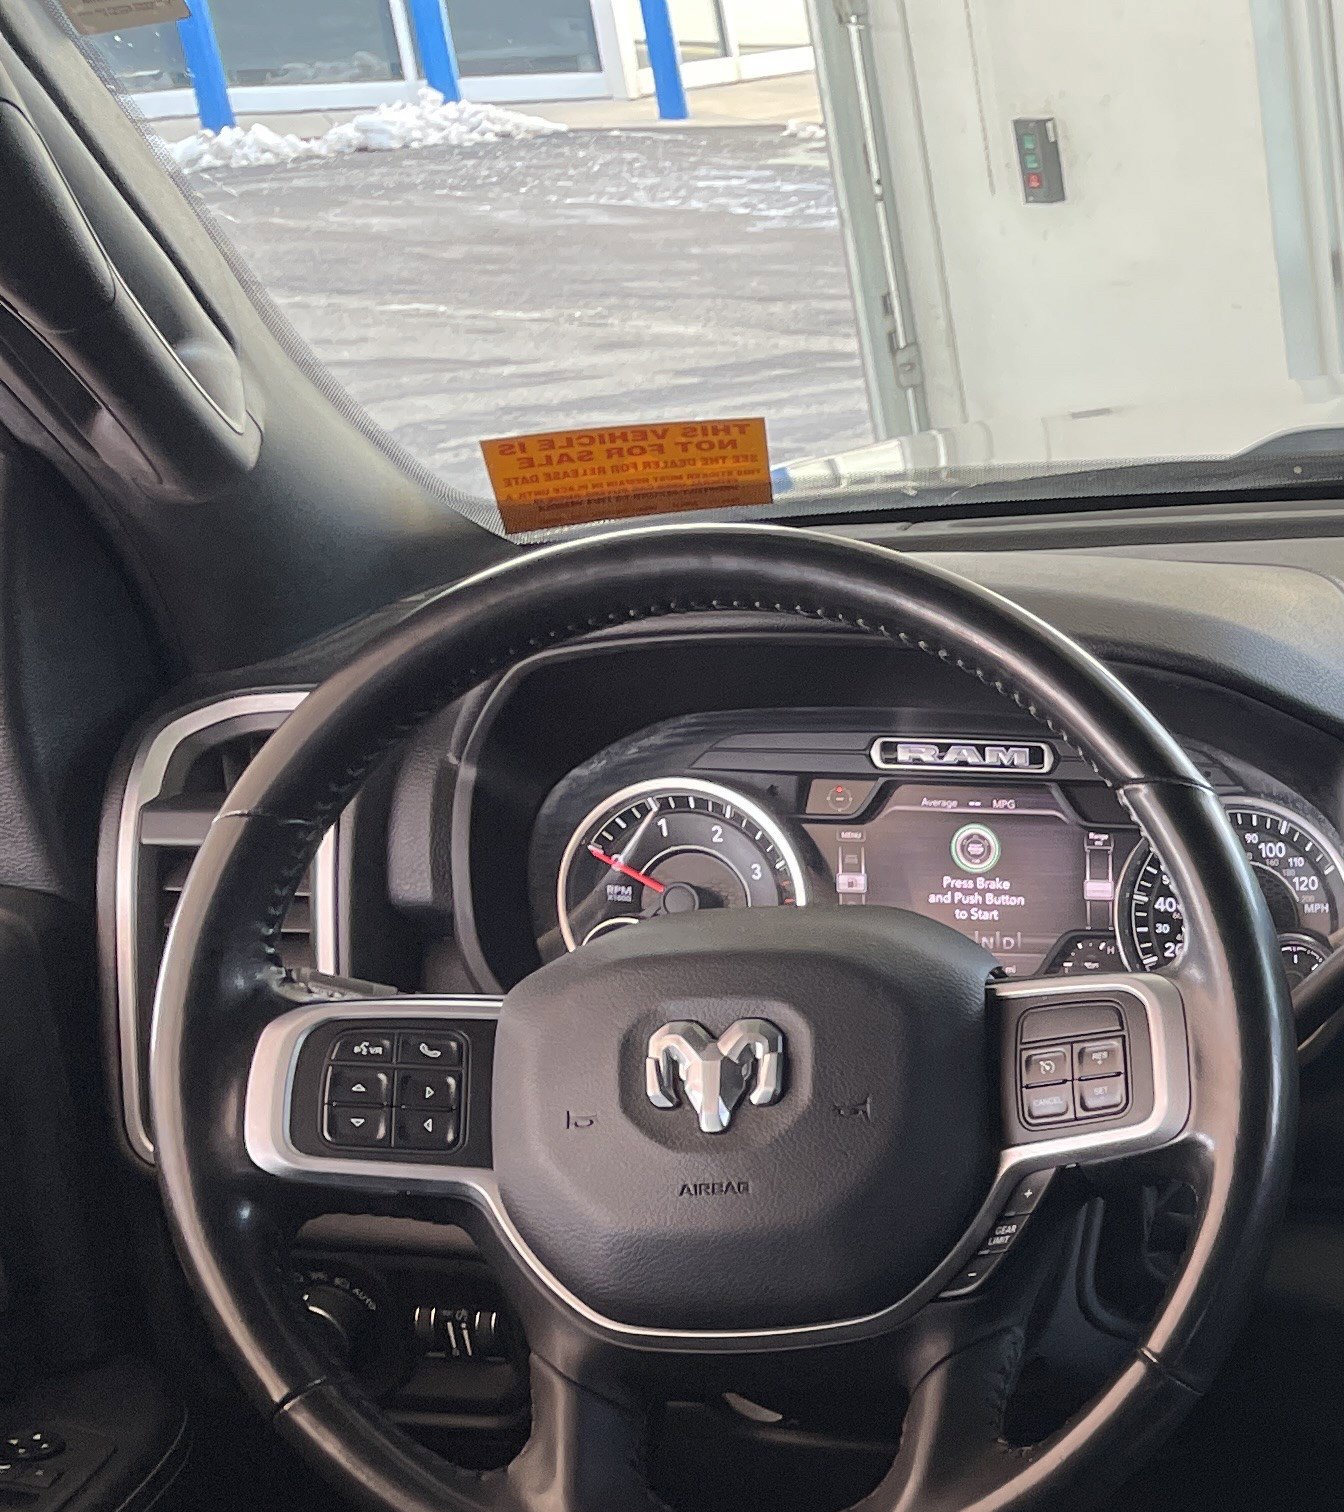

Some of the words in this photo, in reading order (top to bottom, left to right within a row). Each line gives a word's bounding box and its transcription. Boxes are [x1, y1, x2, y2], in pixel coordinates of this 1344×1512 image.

[896, 743, 1030, 767] RAM
[921, 797, 959, 809] Average
[992, 799, 1016, 809] MPG
[657, 817, 668, 837] 1
[711, 825, 724, 843] 2
[1245, 832, 1259, 844] 90
[1257, 841, 1286, 859] 100
[1288, 856, 1304, 868] 110
[751, 863, 763, 880] 3
[607, 884, 632, 895] RPM
[943, 876, 974, 889] Press
[976, 876, 1011, 890] Brake
[1293, 875, 1319, 892] 120
[928, 891, 952, 904] and
[954, 892, 982, 904] Push
[985, 892, 1025, 906] Button
[1154, 896, 1177, 913] 40
[954, 908, 968, 920] to
[970, 907, 999, 920] Start
[1304, 902, 1329, 913] MPH
[1155, 922, 1171, 934] 30
[981, 936, 994, 949] N
[1002, 936, 1015, 950] D
[1106, 945, 1115, 955] H
[1094, 1086, 1108, 1095] SET
[679, 1181, 751, 1197] AIRBAG
[995, 1224, 1017, 1236] GEAR
[988, 1235, 1011, 1246] LIMIT
